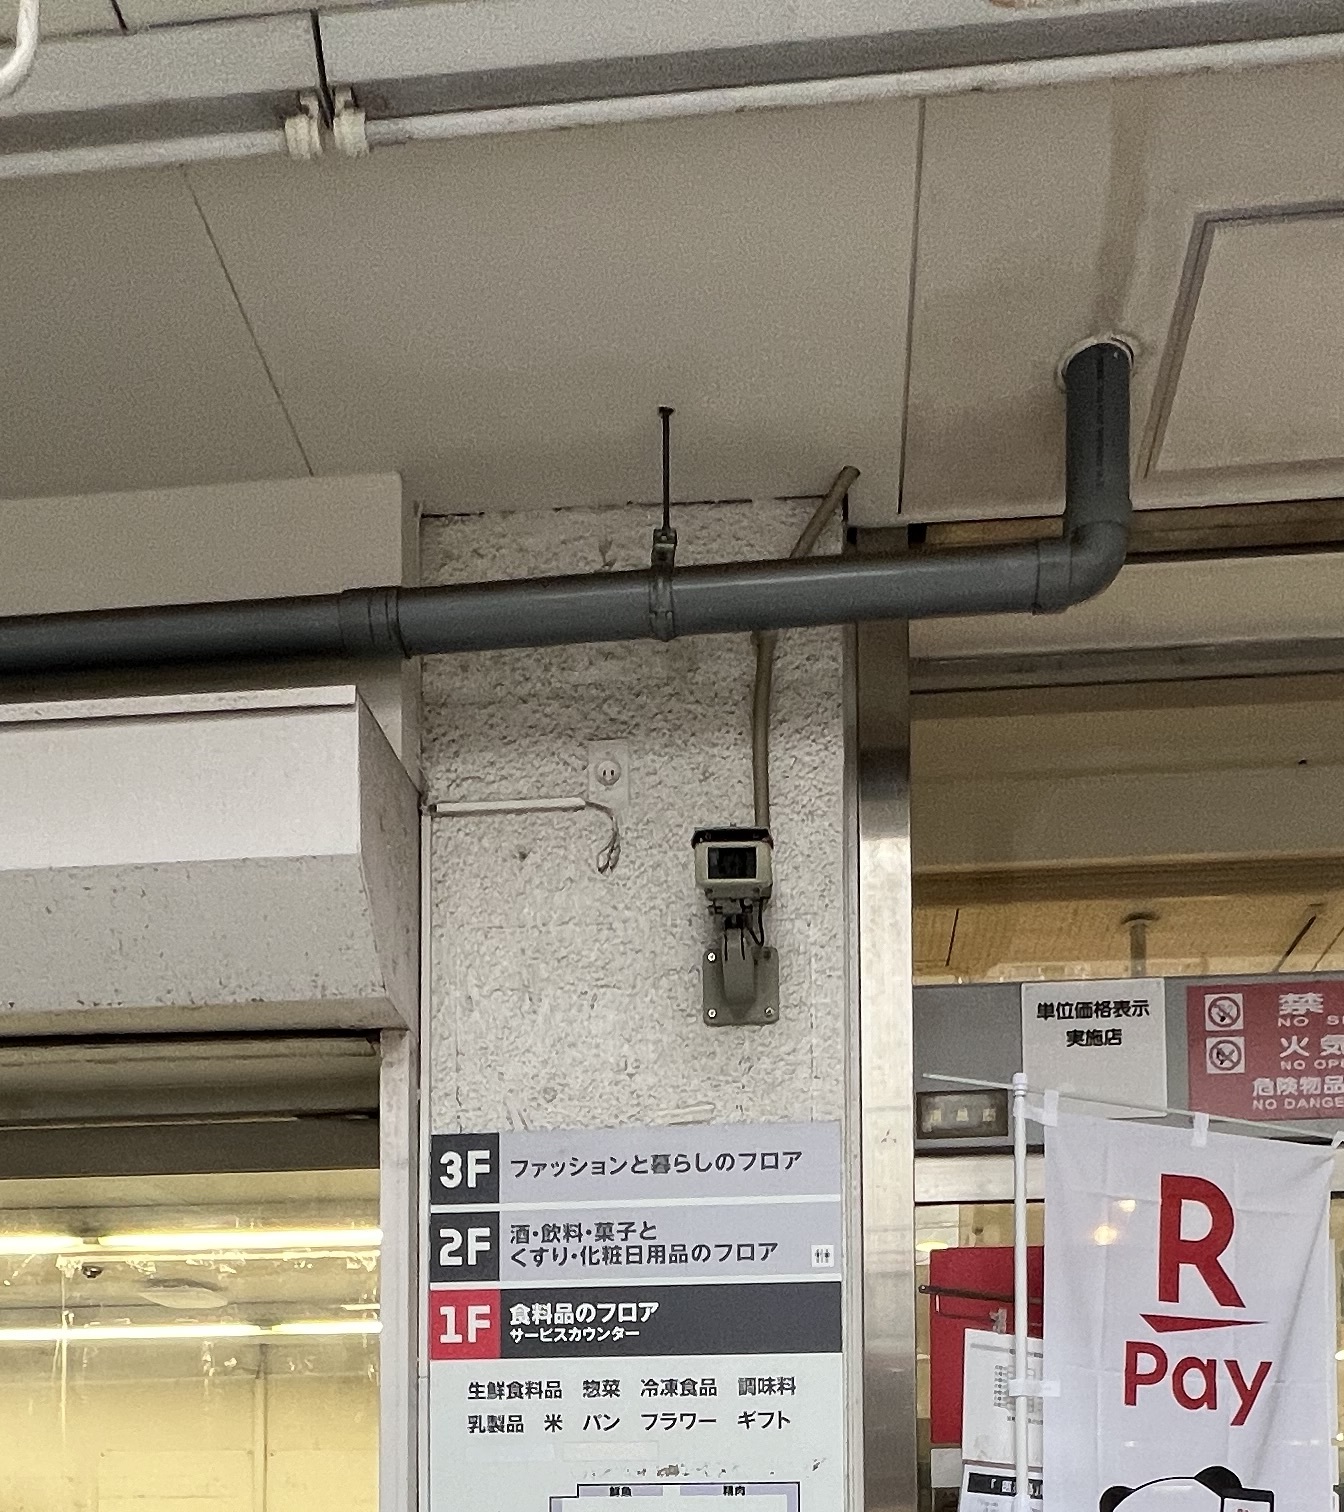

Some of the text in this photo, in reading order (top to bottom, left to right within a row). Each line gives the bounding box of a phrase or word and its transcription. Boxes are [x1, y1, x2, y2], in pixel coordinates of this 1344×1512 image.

[1036, 999, 1150, 1021] 単位価格表示
[1277, 1015, 1310, 1027] NO
[1065, 1026, 1123, 1048] 実施店
[1280, 1059, 1306, 1070] NO
[1252, 1098, 1278, 1110] NO
[439, 1150, 491, 1189] 3F
[509, 1151, 803, 1179] ファッションと暮らしのフロア
[439, 1228, 491, 1267] 2F
[1158, 1173, 1246, 1308] R
[439, 1305, 491, 1344] 1F
[509, 1301, 660, 1326] 食料品のフロア
[509, 1327, 641, 1343] サービスカウンター
[467, 1376, 797, 1400] 生鮮食料品 惣菜 冷凍食品 調味料
[1124, 1341, 1273, 1426] Pay
[467, 1411, 792, 1434] 乳製品 米 パン フラワー ギフト
